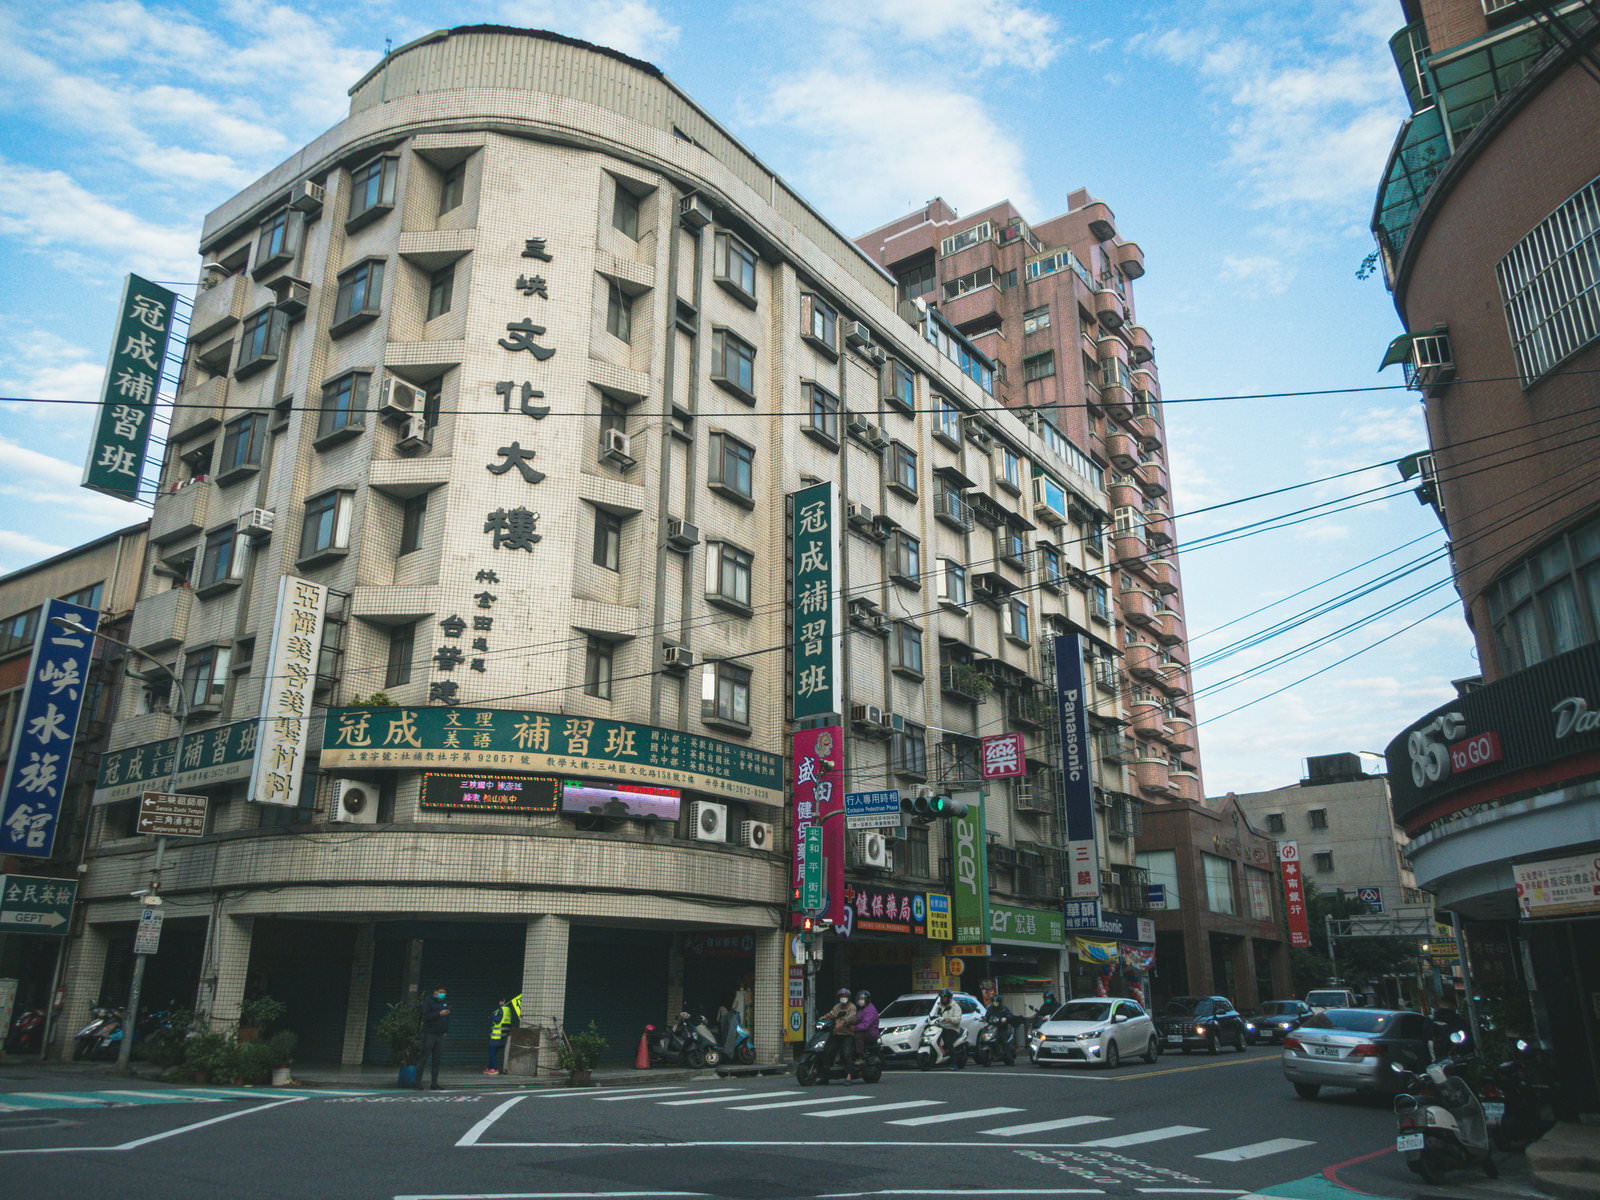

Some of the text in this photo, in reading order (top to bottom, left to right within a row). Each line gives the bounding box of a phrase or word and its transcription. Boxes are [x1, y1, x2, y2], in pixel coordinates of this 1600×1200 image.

[97, 294, 166, 478] 冠成補習班
[484, 237, 556, 553] 三峽文化大樓
[797, 500, 830, 698] 冠成補習班
[6, 612, 85, 848] 三峽水族館
[335, 710, 638, 758] 冠成 補習班
[446, 710, 493, 727] 文理
[1063, 689, 1081, 782] Panasonic
[104, 723, 258, 784] 冠成 補習班
[443, 731, 492, 749] 美語
[478, 752, 514, 764] 92057
[1452, 738, 1490, 768] to GO
[847, 791, 898, 806] 行人專用時相
[808, 844, 819, 893] 和平街
[957, 819, 976, 895] acer
[6, 882, 73, 905] 全民英檢
[856, 890, 911, 922] 健保藥局
[1286, 863, 1302, 915] 華南銀行
[16, 913, 45, 922] GEPT
[990, 910, 1012, 932] er
[1014, 913, 1036, 935] 宏碁
